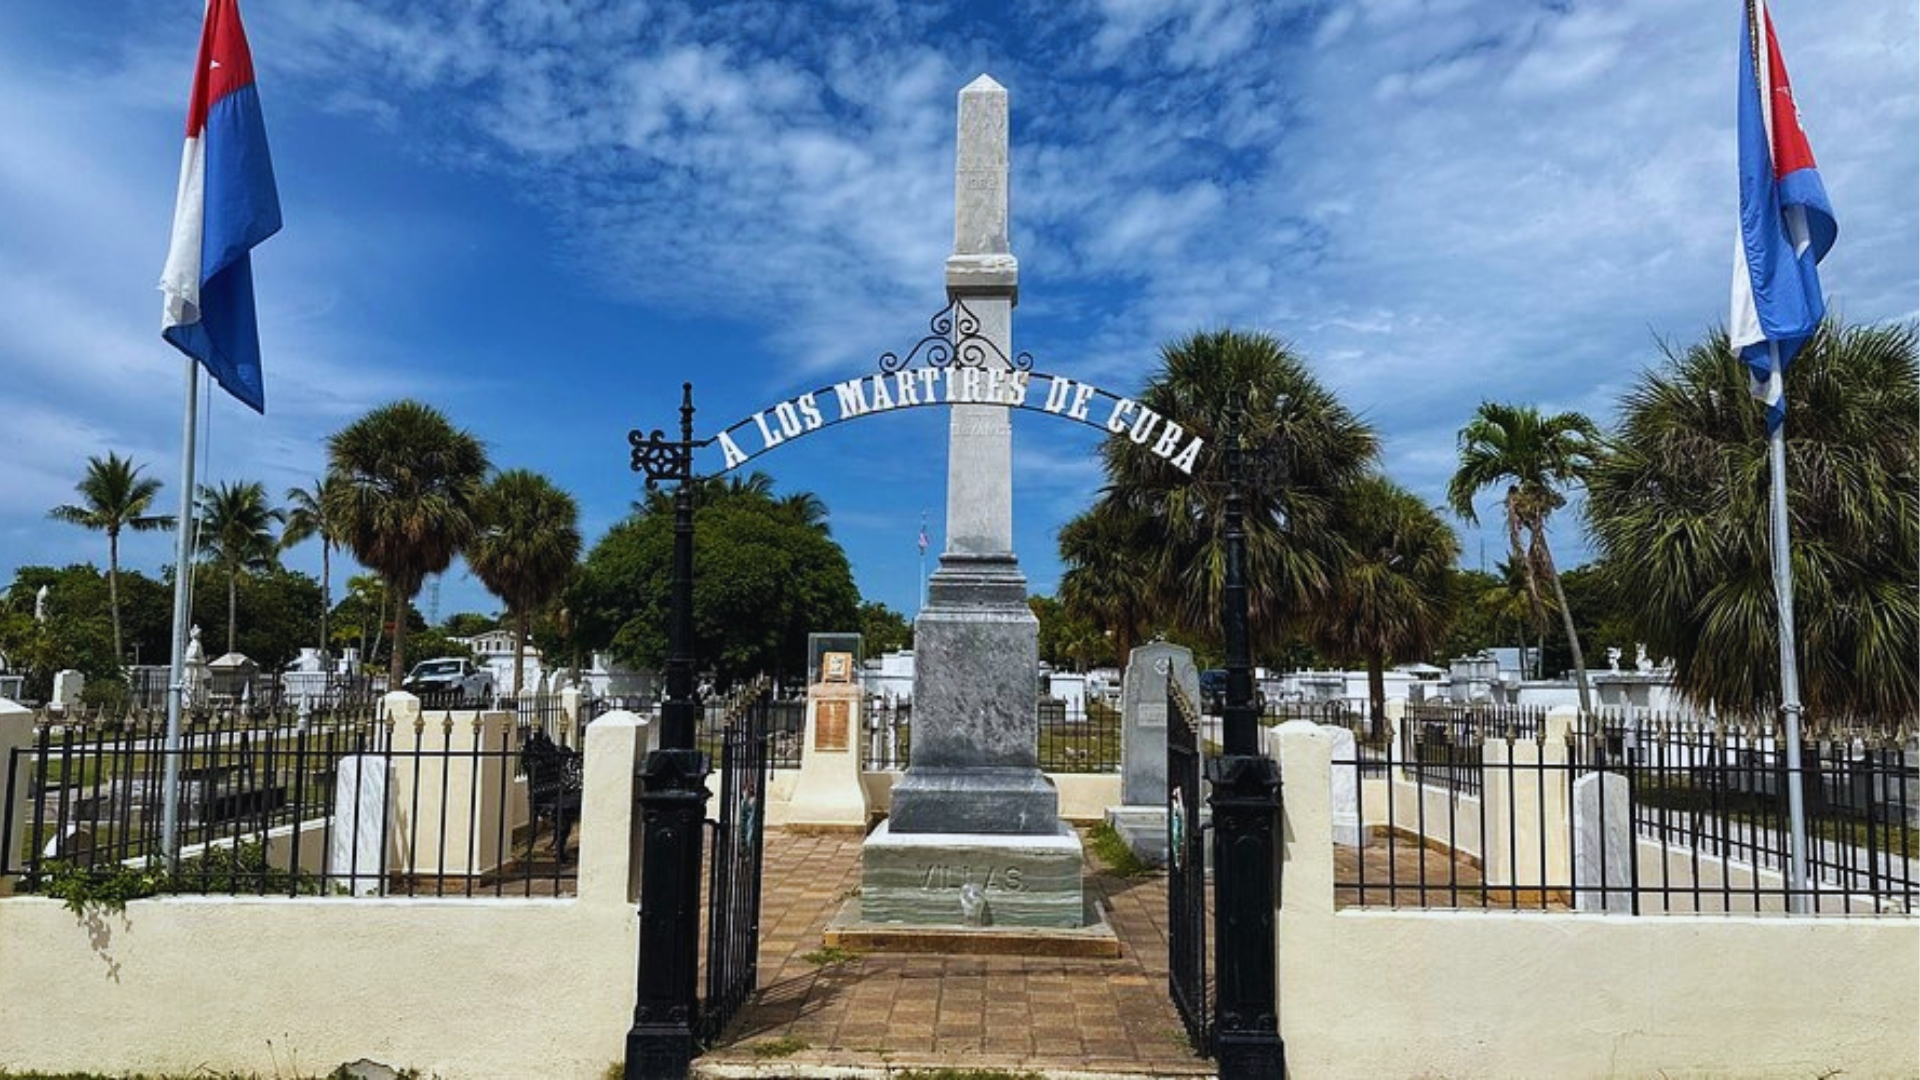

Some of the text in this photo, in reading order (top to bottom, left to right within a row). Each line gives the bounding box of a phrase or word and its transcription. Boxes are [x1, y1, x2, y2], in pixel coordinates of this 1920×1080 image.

[717, 366, 1204, 475] A LOS MARTIRES DE CUBA
